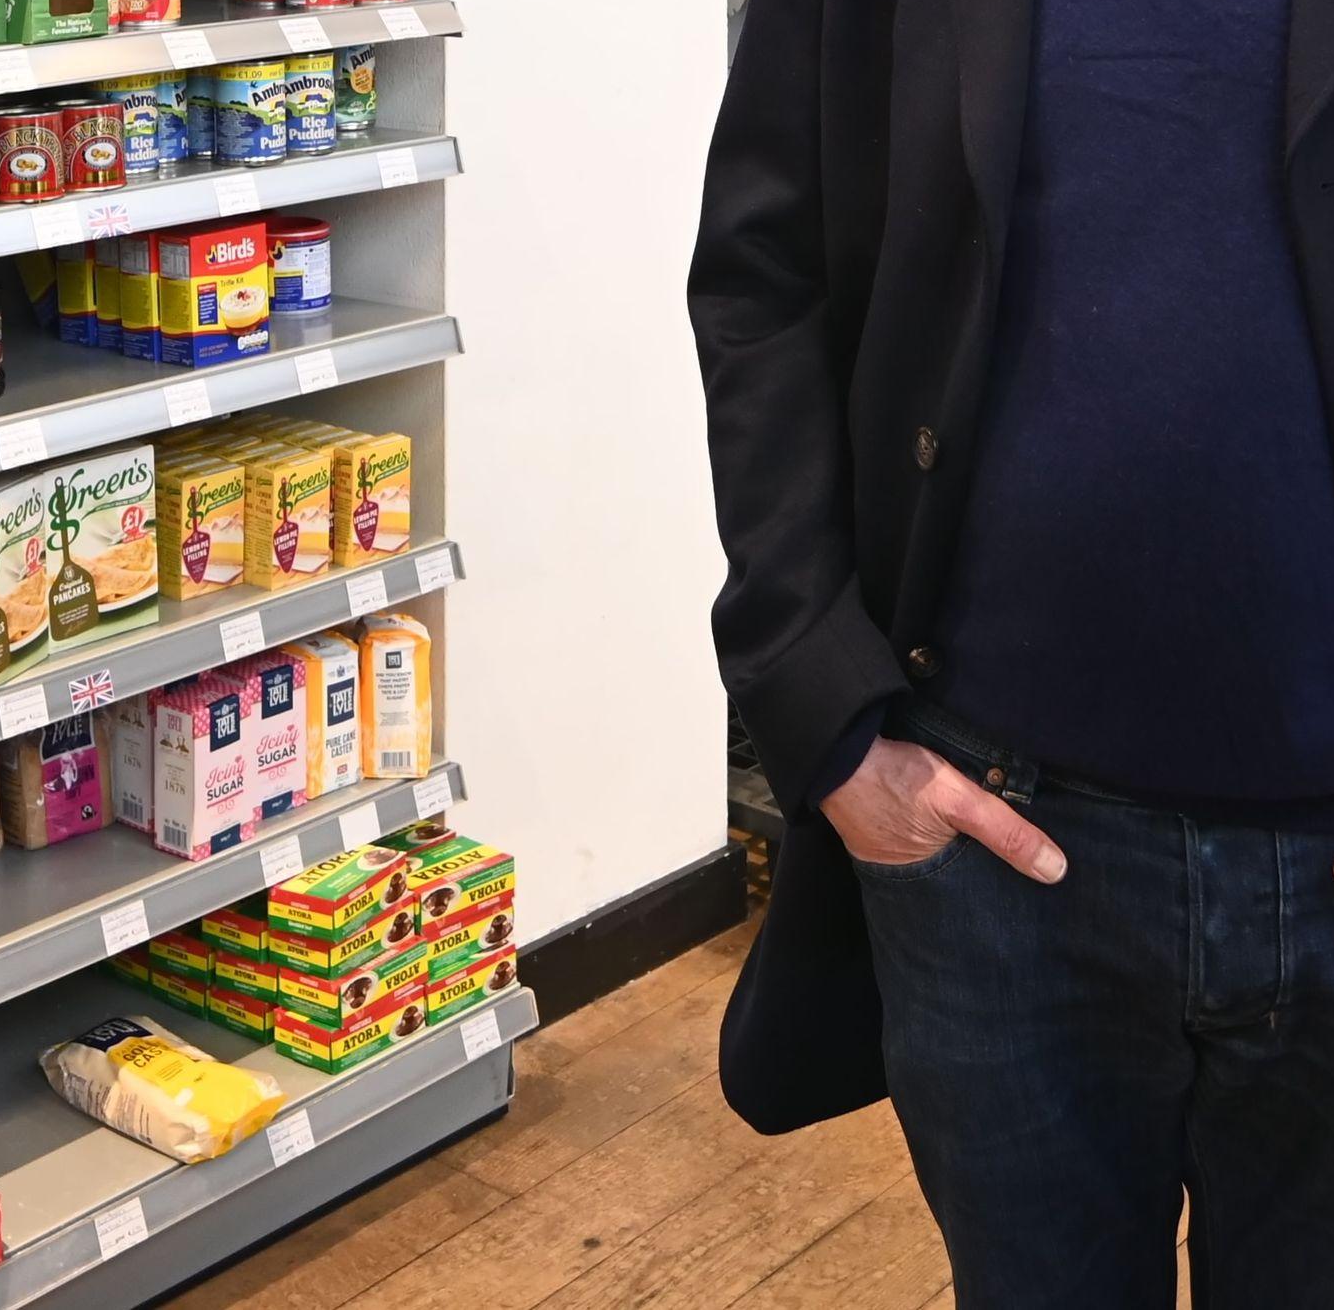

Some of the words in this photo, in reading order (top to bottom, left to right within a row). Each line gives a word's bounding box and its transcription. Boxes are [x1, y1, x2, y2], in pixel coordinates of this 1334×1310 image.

[55, 19, 67, 27] The
[301, 117, 327, 129] Rice
[131, 137, 154, 150] Rice
[288, 127, 335, 141] Pudding
[216, 237, 257, 264] Bird's
[47, 458, 148, 552] Green's
[357, 518, 376, 531] FILLING
[182, 542, 201, 557] LEMON
[201, 539, 210, 550] PIE
[187, 548, 208, 563] FILLING
[278, 539, 297, 552] FILLING
[53, 582, 91, 606] PANCAKES
[267, 681, 289, 698] TATE
[330, 687, 354, 706] TATE
[330, 697, 354, 717] LYLE
[216, 710, 238, 730] TATE
[256, 727, 300, 755] Icing
[326, 735, 341, 750] PURE
[341, 729, 356, 745] CANE
[257, 743, 297, 768] SUGAR
[331, 742, 354, 759] CASTER
[204, 756, 245, 789] Icing
[206, 775, 245, 802] SUGAR
[468, 878, 507, 903] ATORA
[288, 908, 312, 920] ATORA
[343, 891, 375, 921] ATORA
[340, 930, 375, 959] ATORA
[433, 929, 471, 955] ATORA
[385, 962, 421, 990] ATORA
[439, 977, 476, 1004] ATORA
[342, 1024, 382, 1052] ATORA
